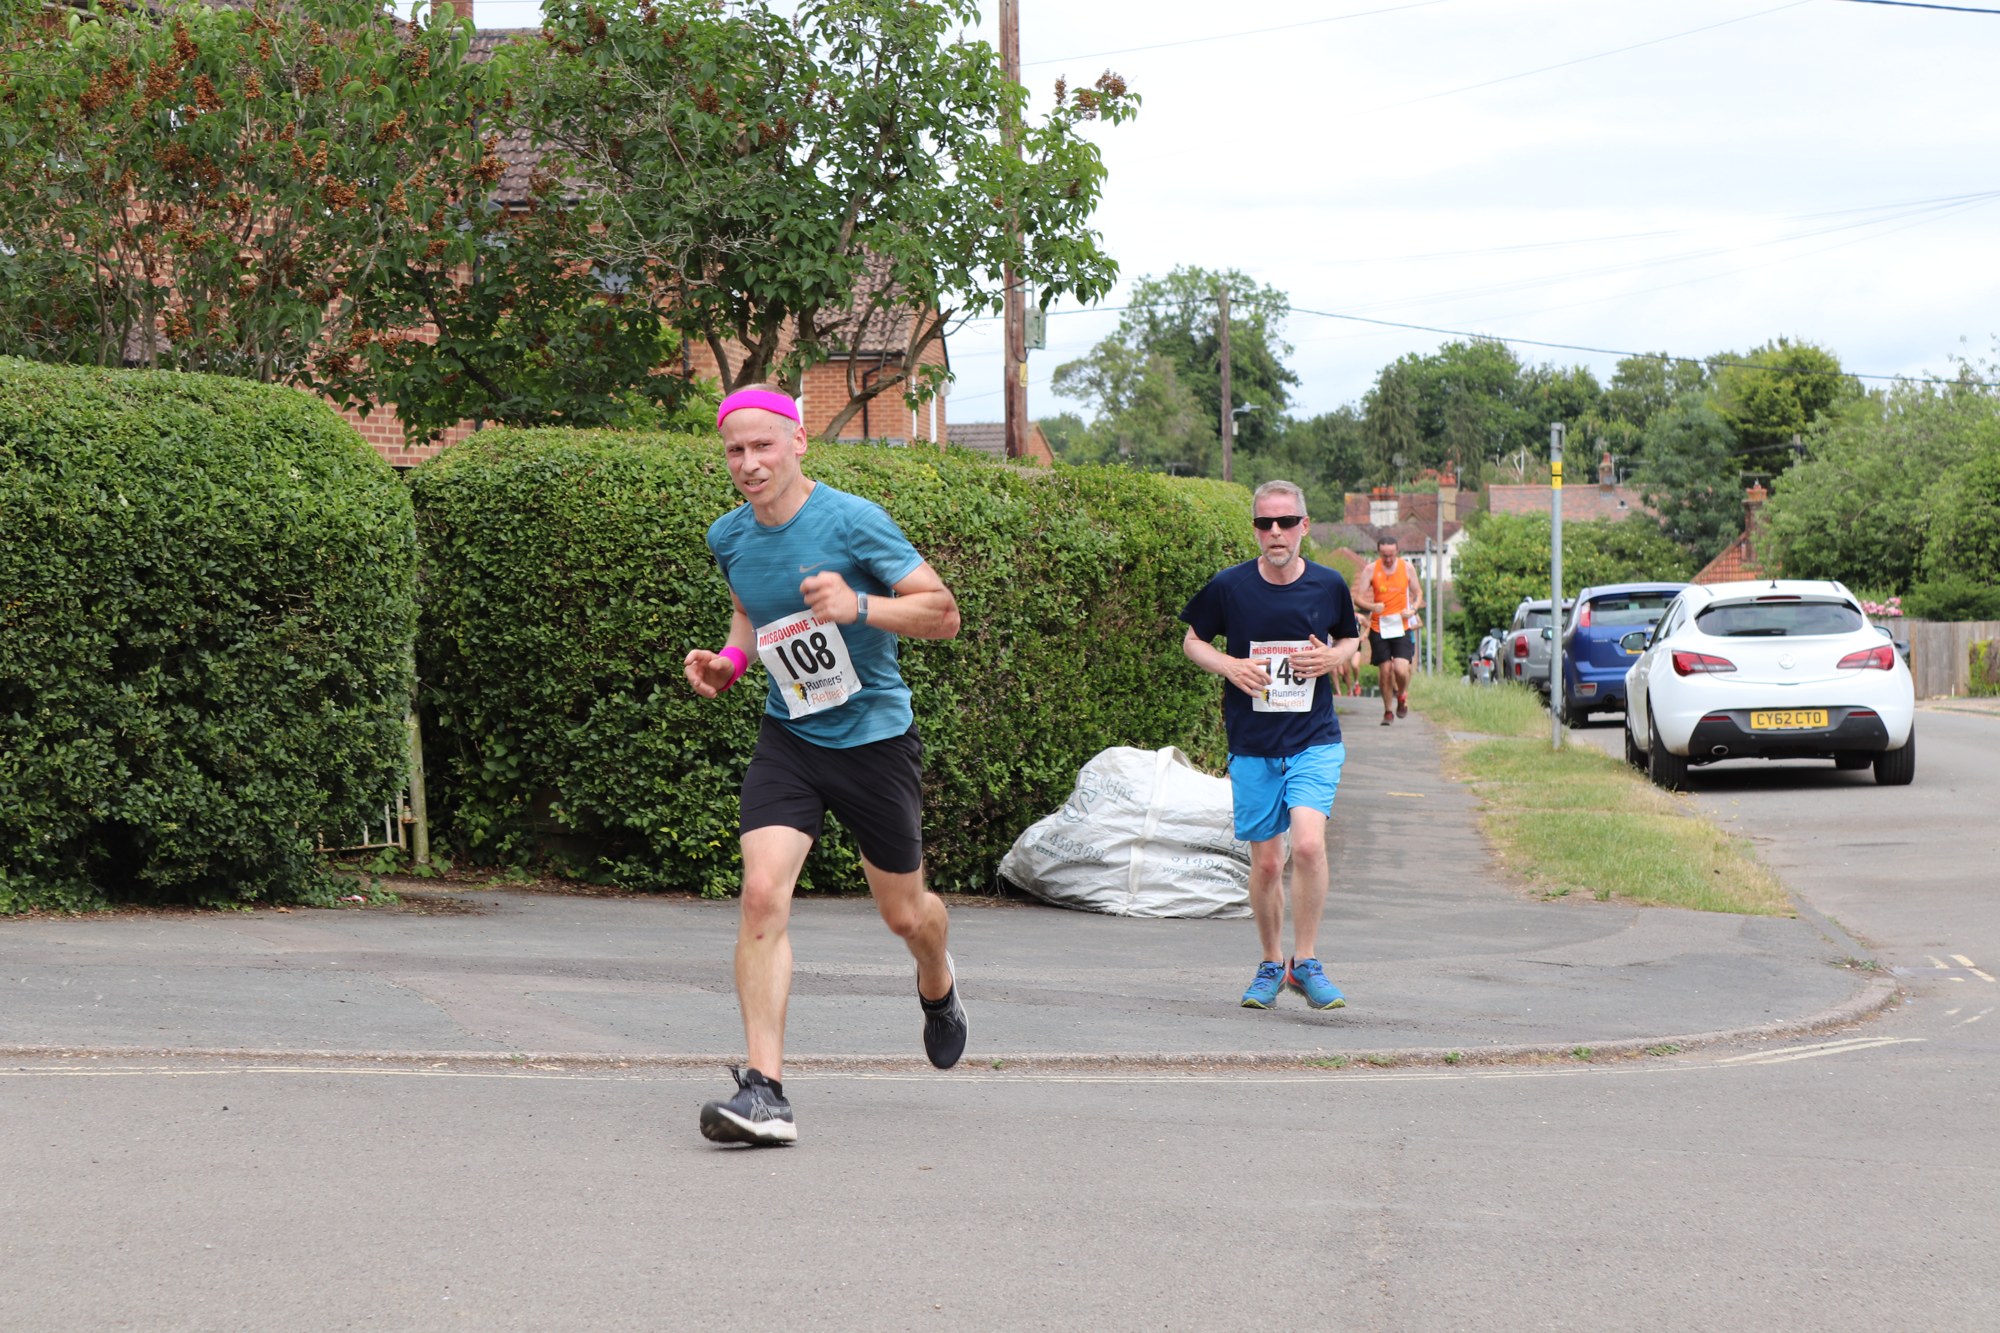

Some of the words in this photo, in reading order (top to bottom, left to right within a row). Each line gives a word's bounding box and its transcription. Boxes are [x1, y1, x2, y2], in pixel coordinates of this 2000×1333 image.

[759, 619, 811, 648] MISBOURNE
[776, 631, 836, 680] 108
[805, 671, 843, 691] Runners'
[1272, 689, 1307, 698] Runners'
[1756, 713, 1792, 726] CY62
[1795, 711, 1822, 724] CTO
